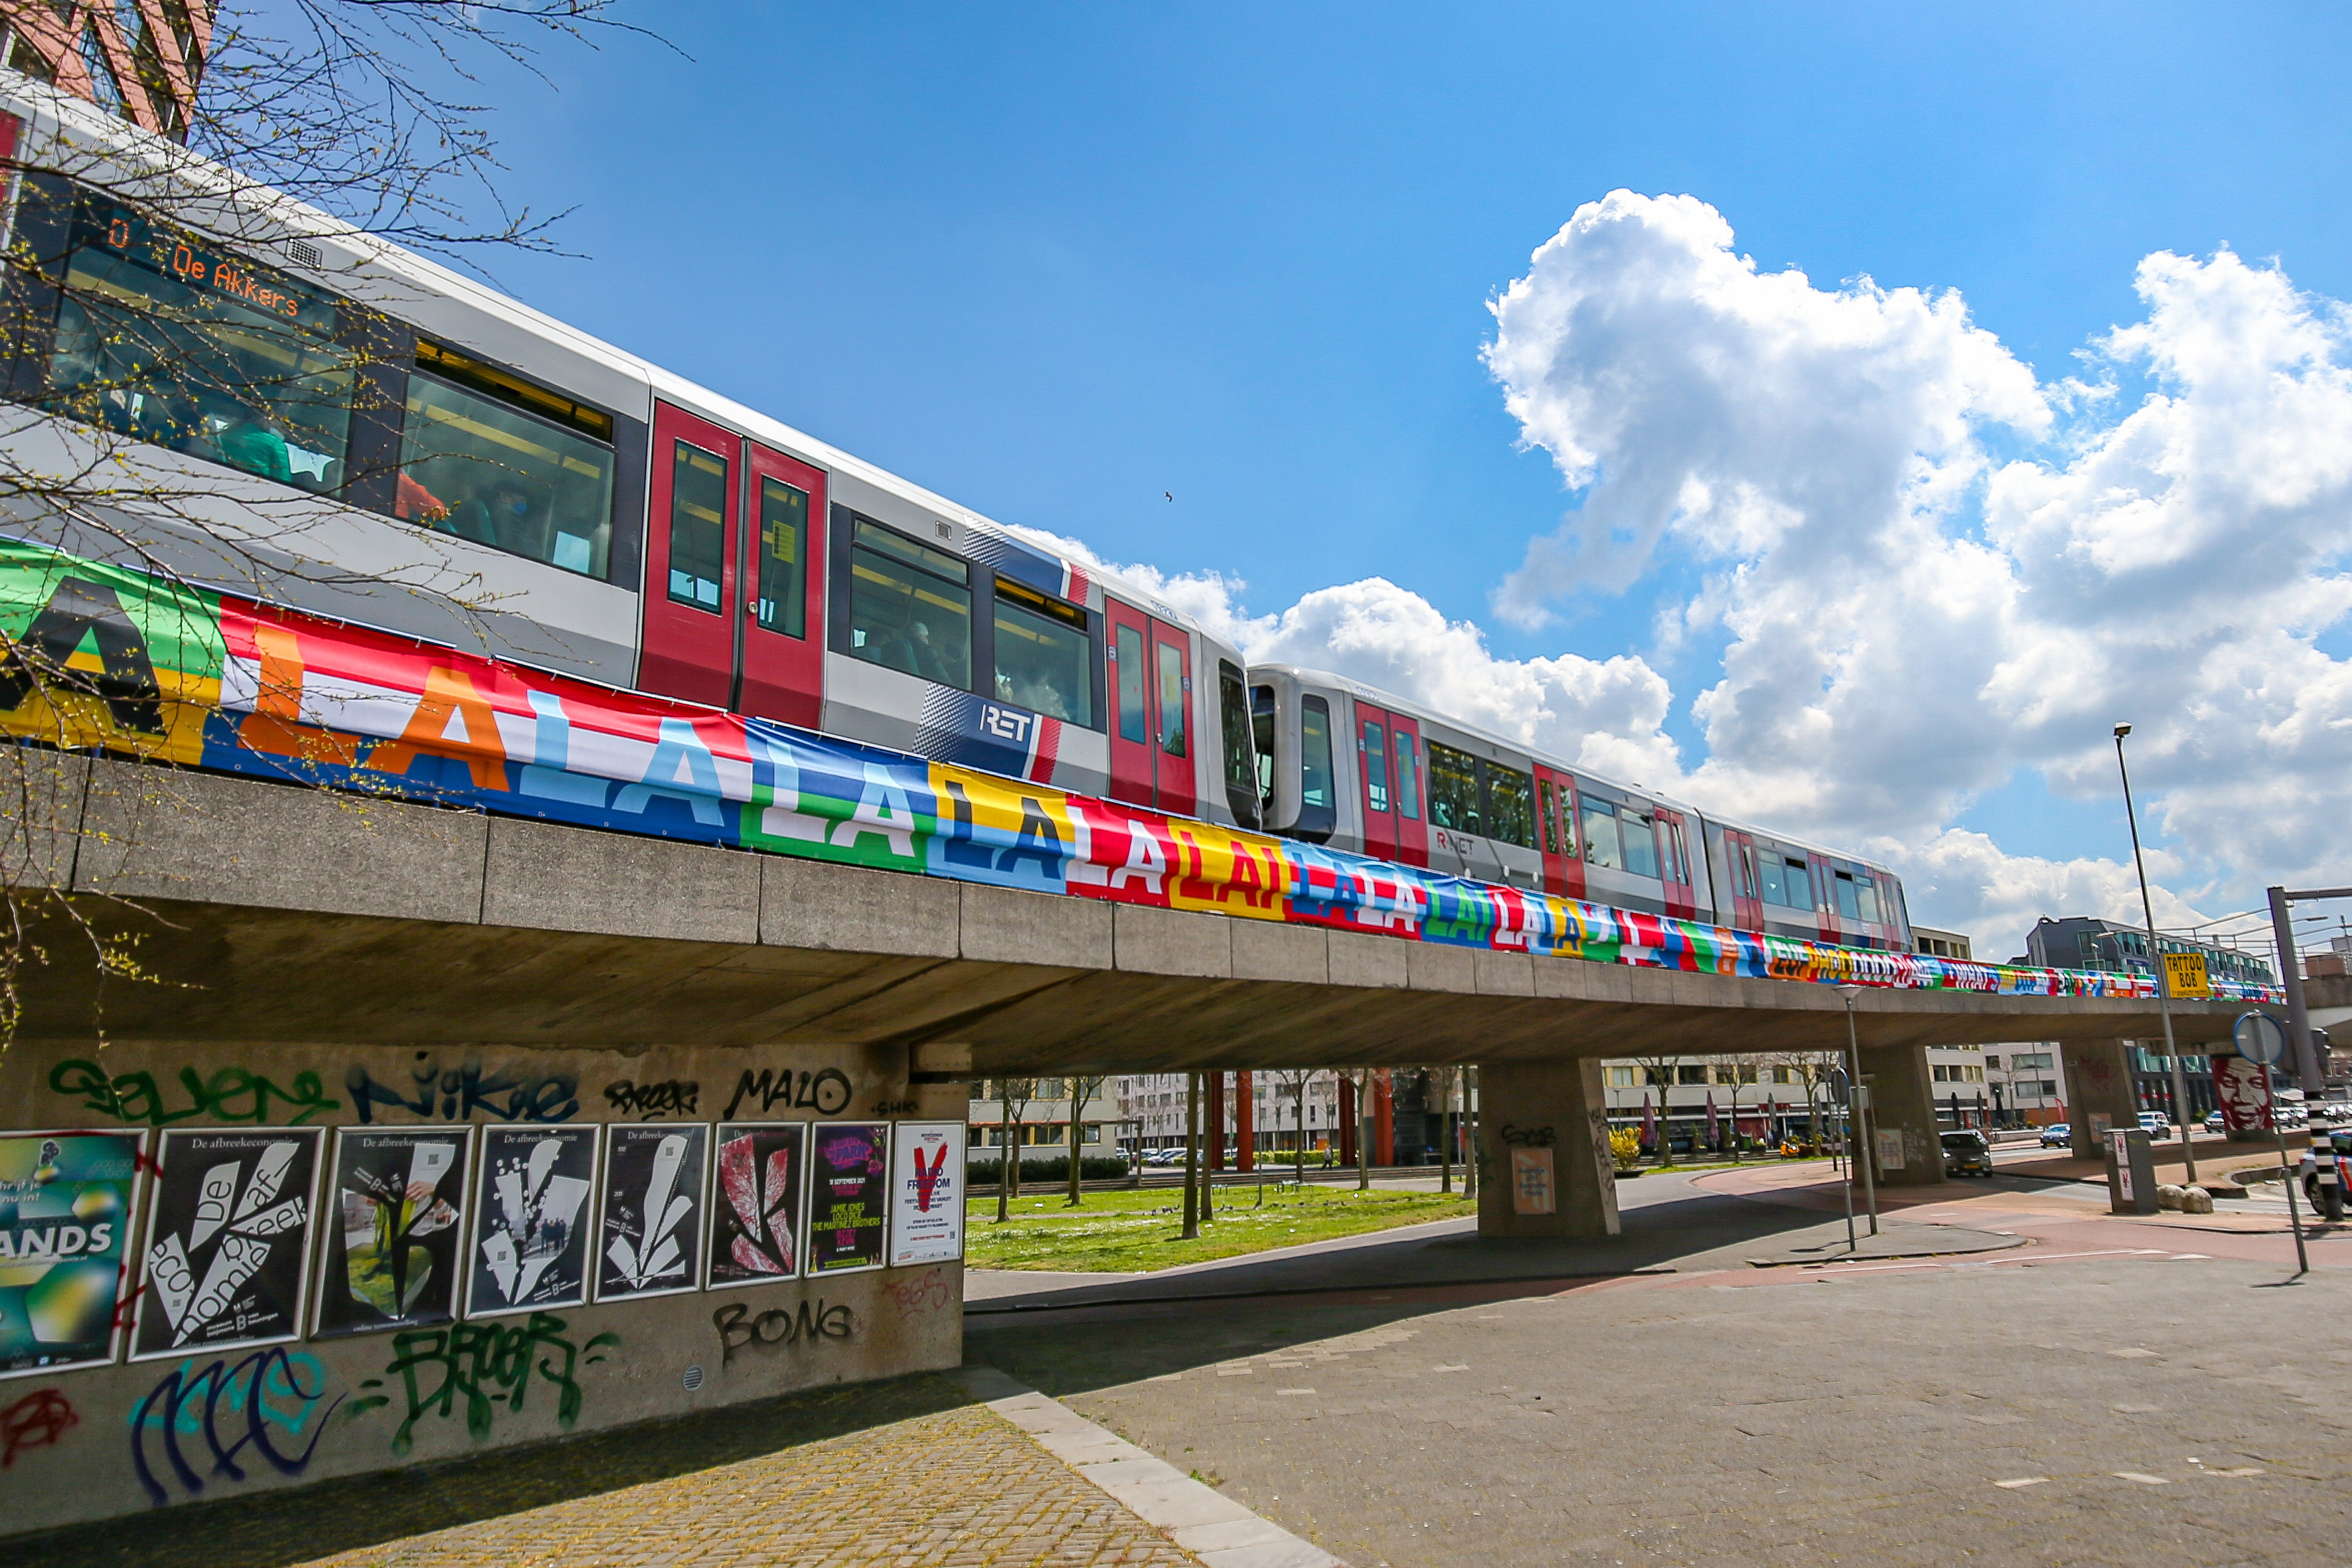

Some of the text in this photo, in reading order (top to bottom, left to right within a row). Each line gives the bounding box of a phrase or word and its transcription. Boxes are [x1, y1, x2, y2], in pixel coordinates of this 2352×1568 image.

[173, 245, 299, 317] De Akkers
[980, 704, 1031, 742] RET
[2167, 956, 2202, 972] TATTOO
[2179, 973, 2197, 988] BOB
[363, 1137, 376, 1148] De
[504, 1135, 516, 1144] De
[628, 1131, 638, 1140] De
[193, 1138, 208, 1149] De
[907, 1178, 951, 1190] FREEDOM
[848, 1202, 865, 1212] JONES
[833, 1211, 862, 1221] LOCO DICE
[813, 1217, 880, 1231] THE MARTINEZ BROTHERS
[0, 1222, 114, 1258] ANDS
[236, 1314, 247, 1332] B
[713, 1299, 852, 1368] BONG
